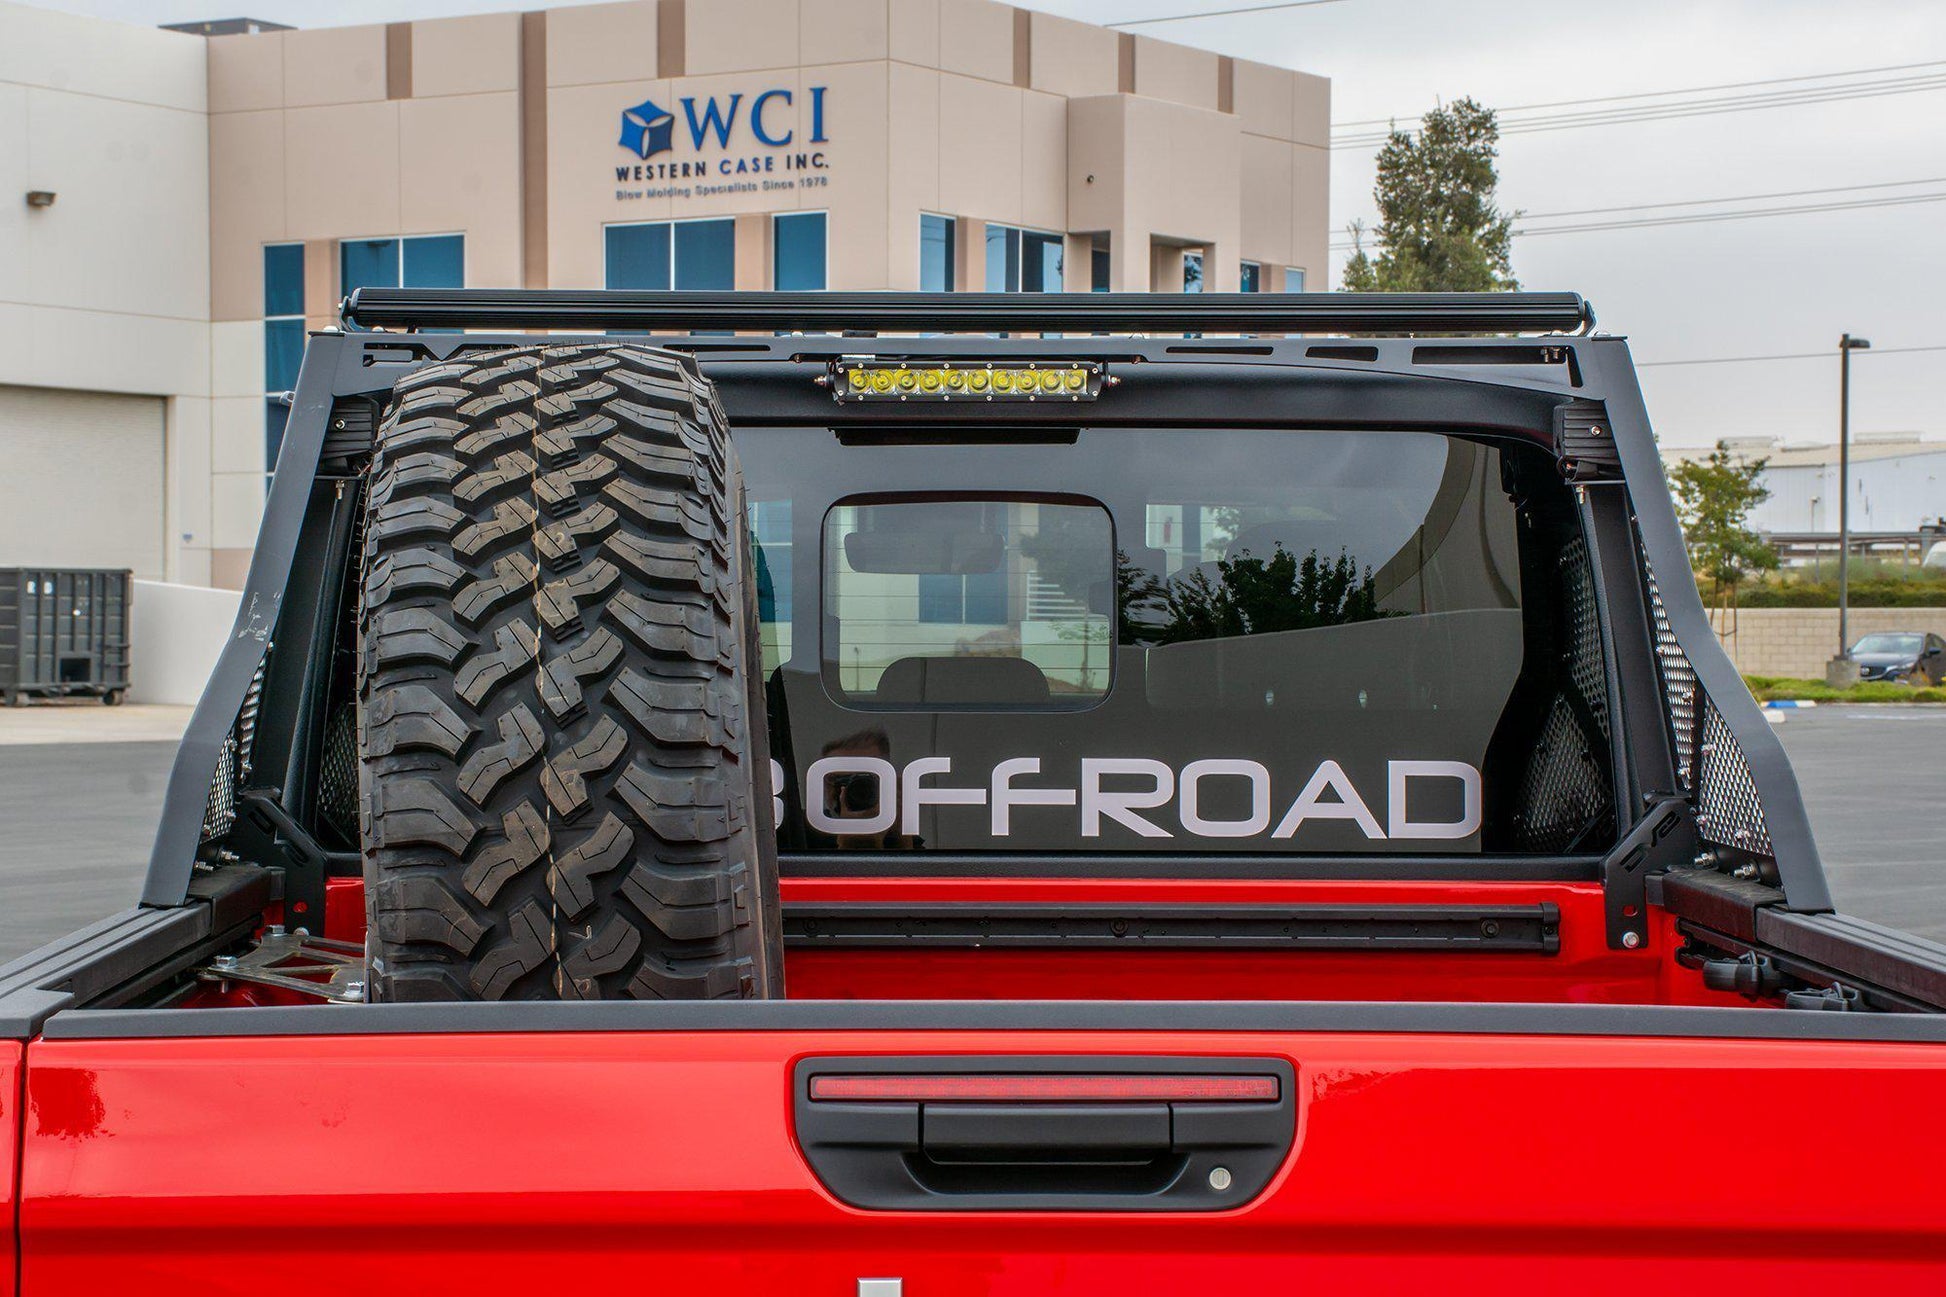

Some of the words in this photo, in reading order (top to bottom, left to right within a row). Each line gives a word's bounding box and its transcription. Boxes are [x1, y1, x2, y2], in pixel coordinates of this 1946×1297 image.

[679, 86, 829, 151] WCI
[616, 161, 706, 182] WESTERN
[719, 156, 774, 175] CASE
[786, 152, 829, 170] INC.
[616, 189, 642, 200] Blow
[647, 185, 691, 198] Molding
[762, 178, 794, 191] Since
